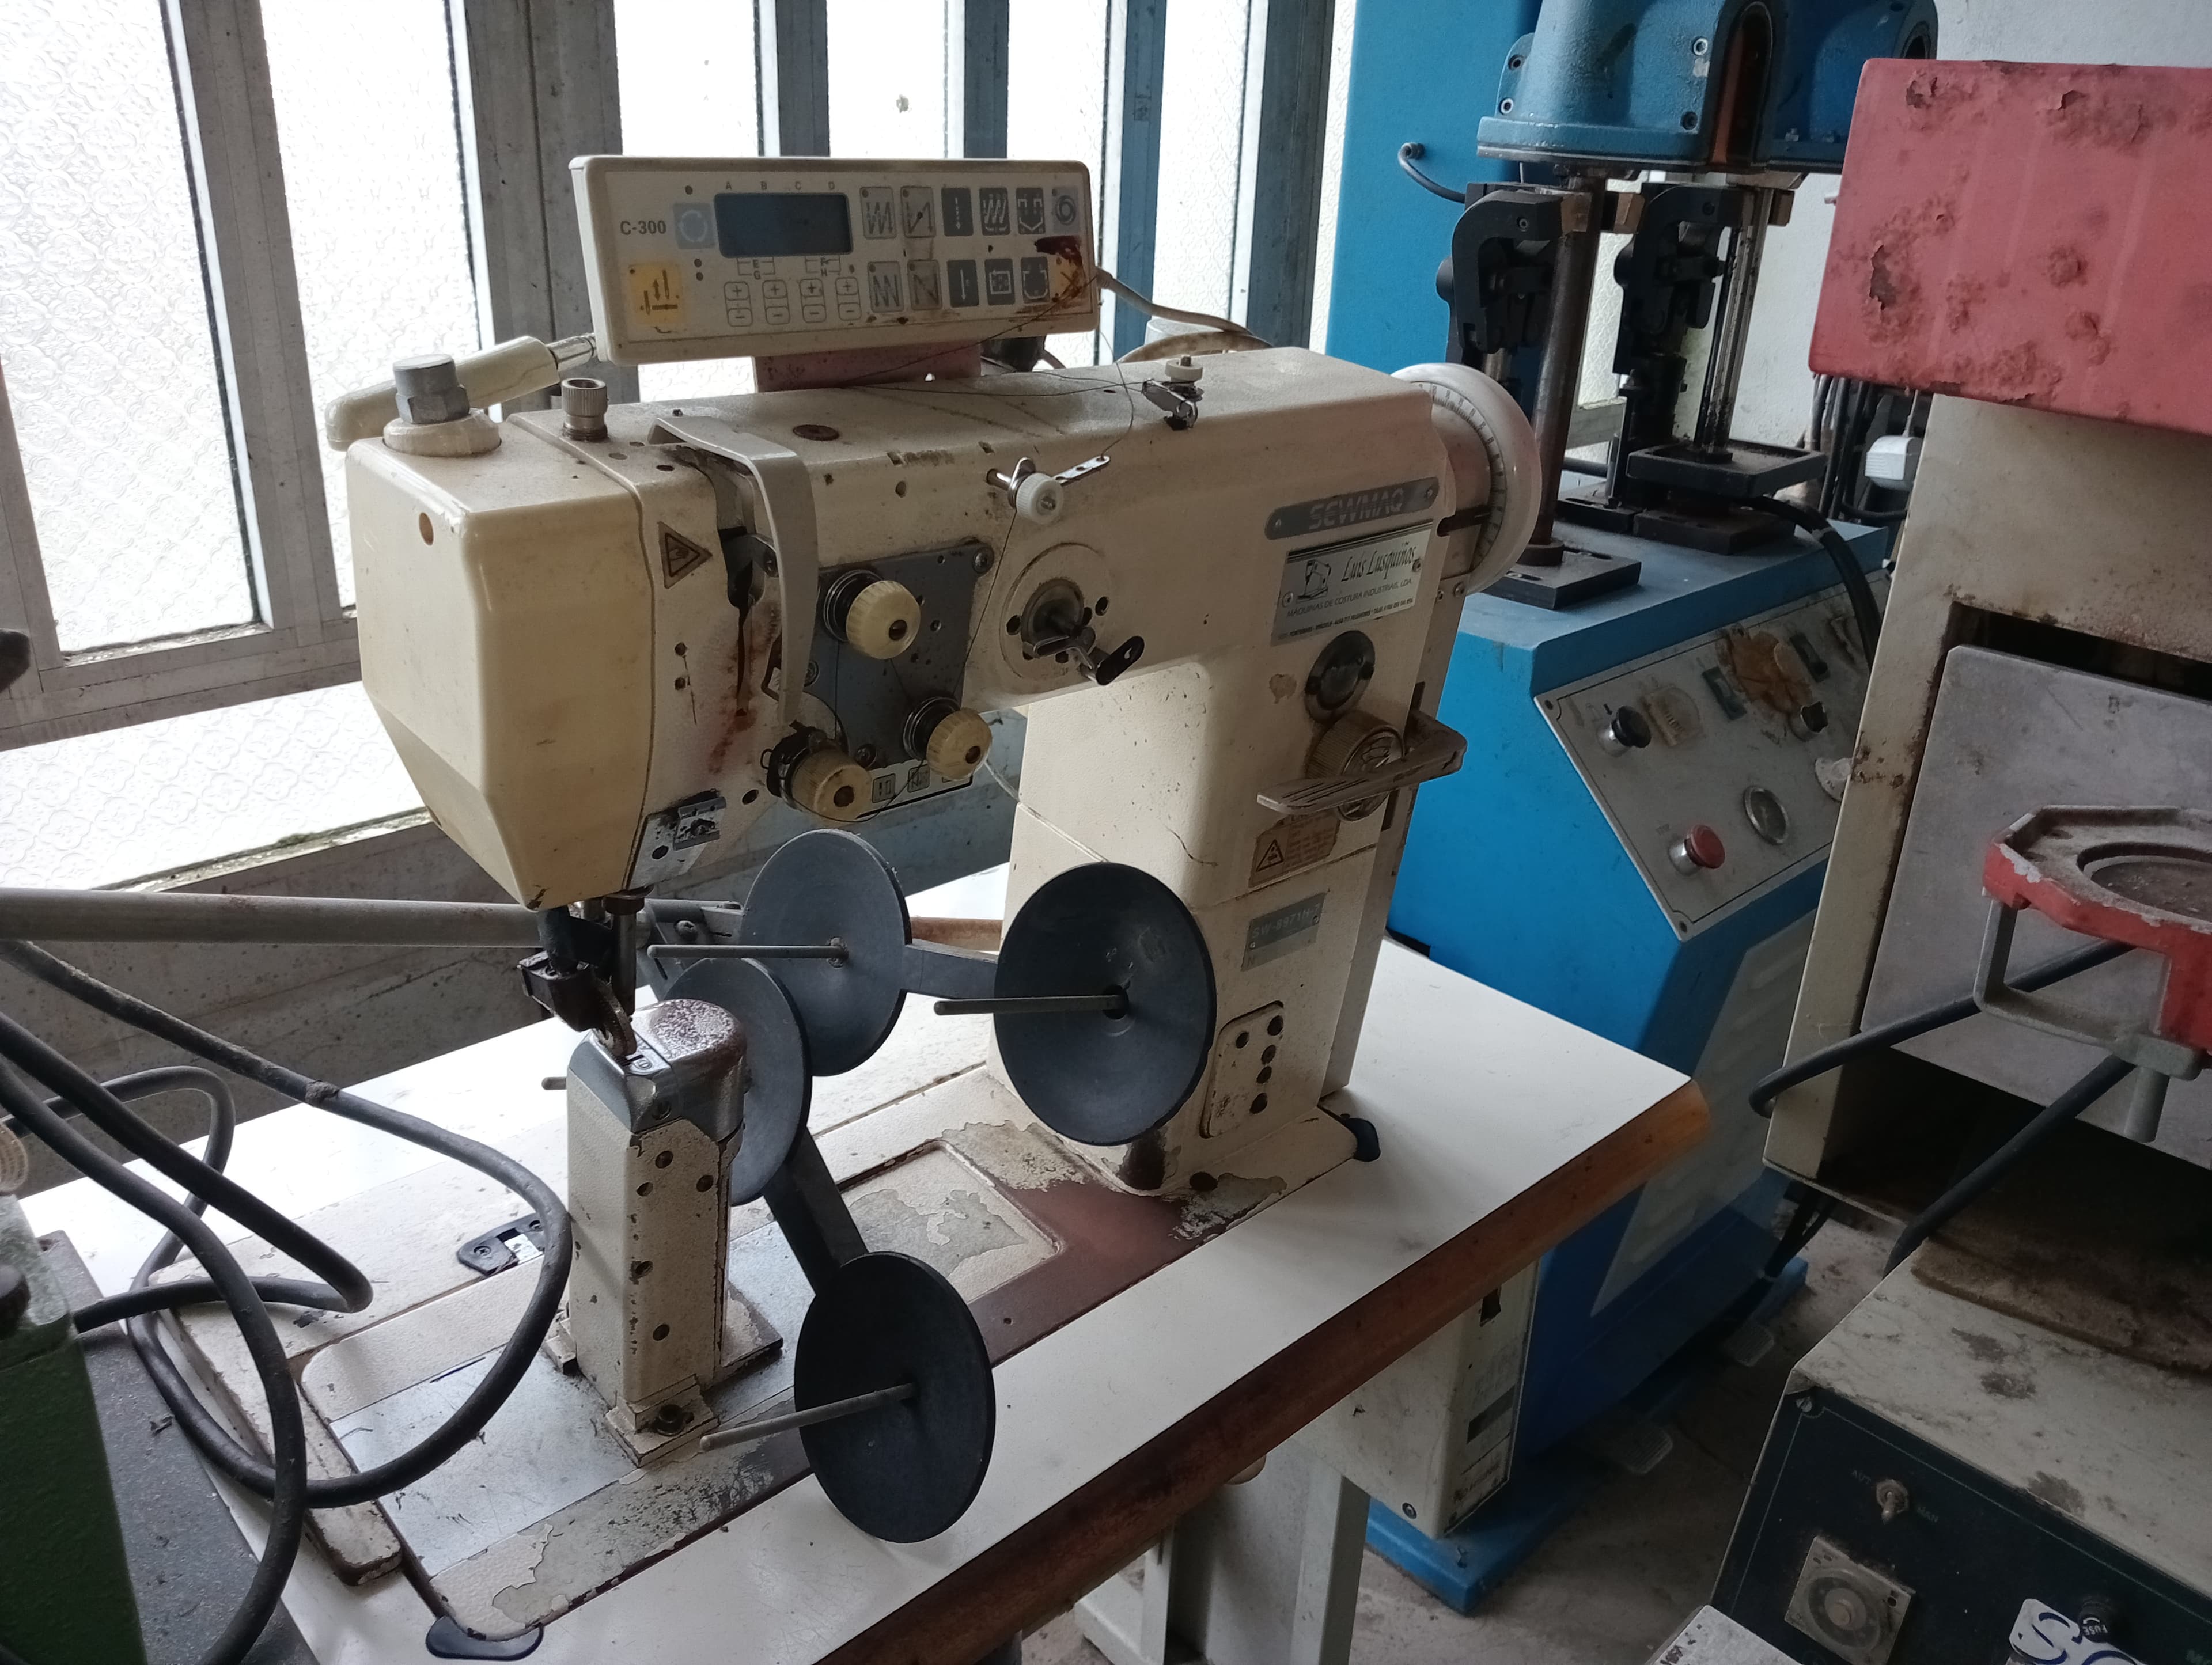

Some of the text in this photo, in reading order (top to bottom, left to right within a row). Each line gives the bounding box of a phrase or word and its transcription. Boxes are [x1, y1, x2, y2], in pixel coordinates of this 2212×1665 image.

[725, 180, 835, 191] A B C D
[619, 219, 667, 236] C-300
[752, 259, 760, 269] E
[753, 268, 828, 280] G H
[1341, 553, 1366, 582] Luis
[1324, 600, 1333, 609] DE
[1334, 591, 1363, 607] COSTURA
[2082, 1624, 2109, 1636] FUSE
